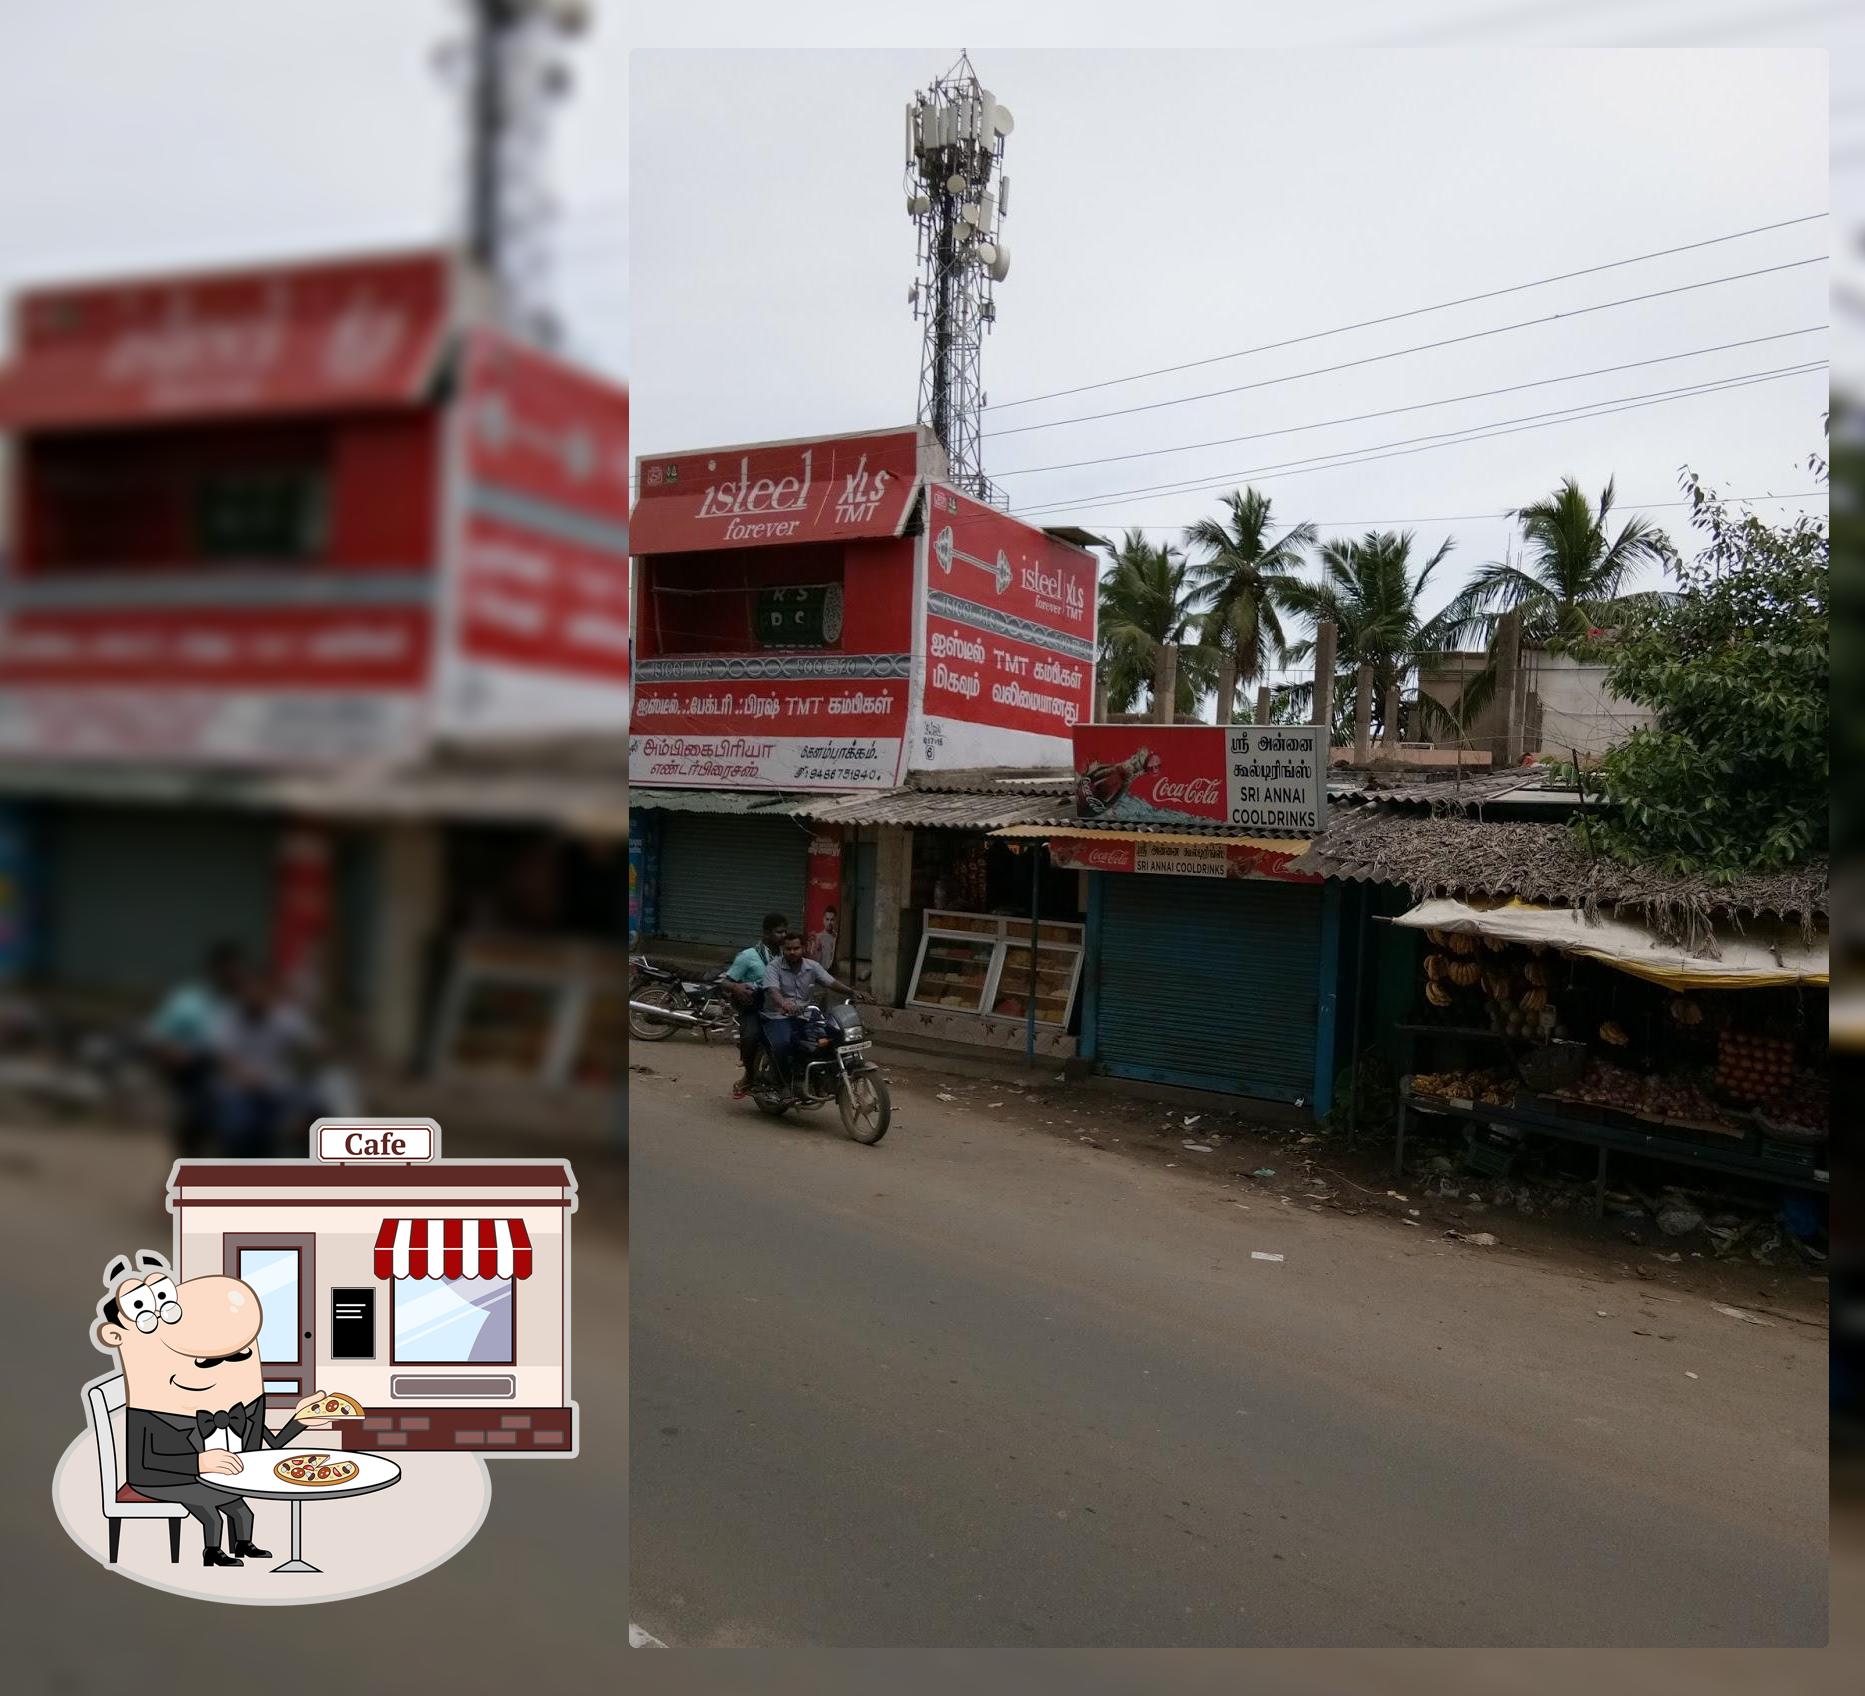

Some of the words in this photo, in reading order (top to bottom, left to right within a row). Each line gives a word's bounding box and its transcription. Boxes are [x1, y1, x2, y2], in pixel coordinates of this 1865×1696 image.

[700, 449, 812, 517] isteel
[838, 453, 890, 504] XLS
[835, 502, 879, 524] TMT
[723, 518, 800, 541] forever
[1021, 555, 1062, 599] isteel
[1066, 575, 1084, 608] XLS
[1035, 594, 1062, 615] forever
[1066, 605, 1083, 621] TMT
[993, 648, 1029, 676] TMT
[785, 696, 824, 717] TMT
[1258, 732, 1313, 752] அன்னை
[1240, 786, 1260, 802] SRI
[1264, 787, 1305, 804] ANNAI
[1232, 808, 1315, 827] COOLDRINKS
[1137, 860, 1149, 871] SRI
[1151, 861, 1175, 873] ANNAI
[1175, 863, 1225, 876] COOLDRINKS
